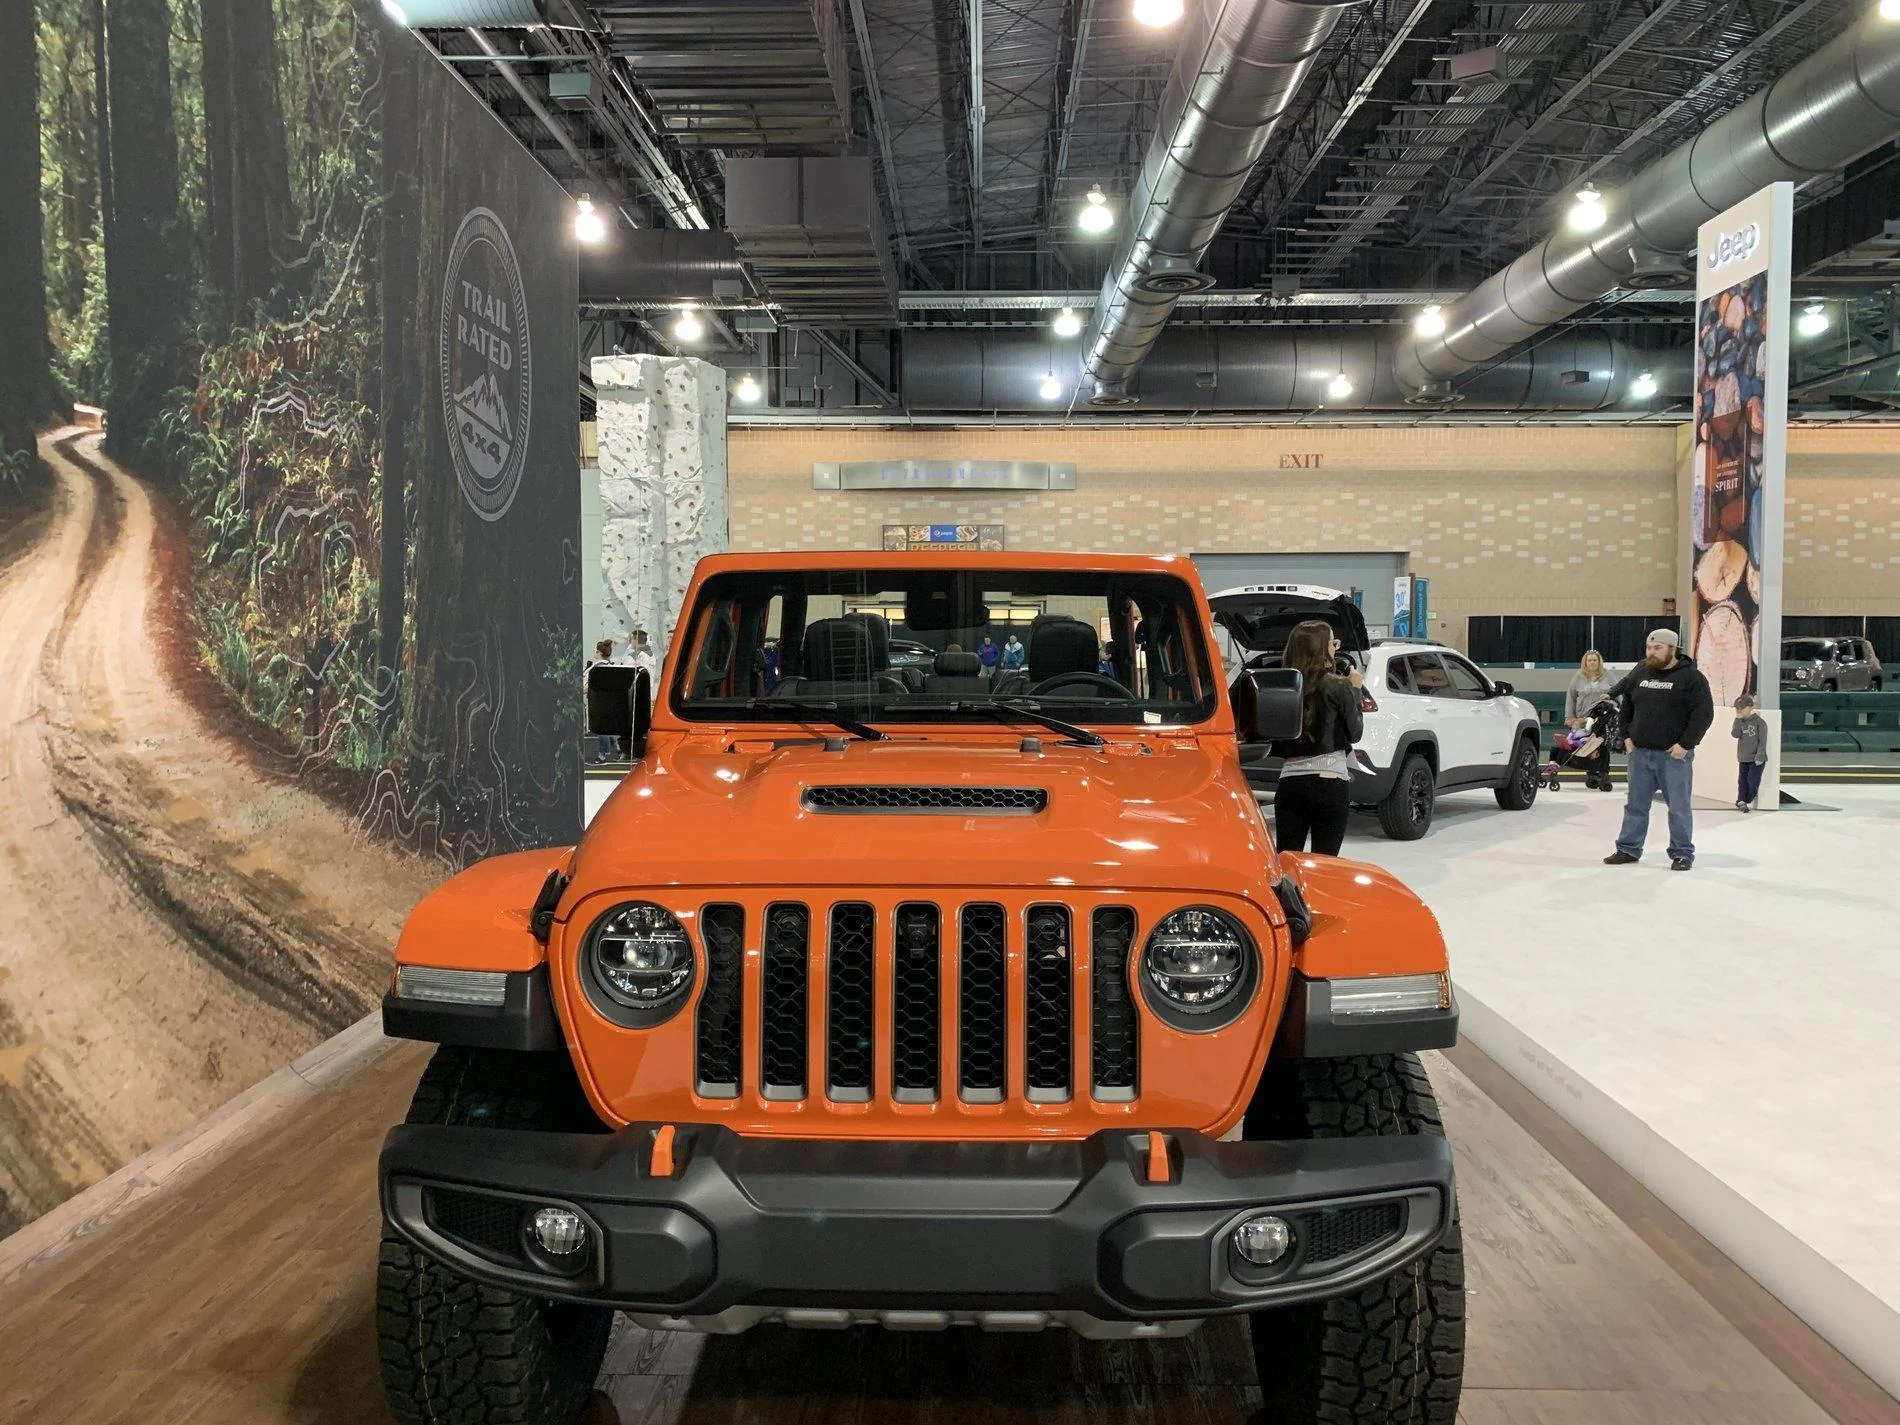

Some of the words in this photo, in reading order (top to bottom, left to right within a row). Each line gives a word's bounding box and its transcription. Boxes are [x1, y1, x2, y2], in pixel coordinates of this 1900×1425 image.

[1707, 224, 1757, 268] Jeep
[462, 280, 511, 334] TRAIL
[458, 314, 512, 371] RATED
[461, 421, 501, 464] 4x4
[1279, 454, 1323, 468] EXIT
[1715, 478, 1739, 492] SPIRIT
